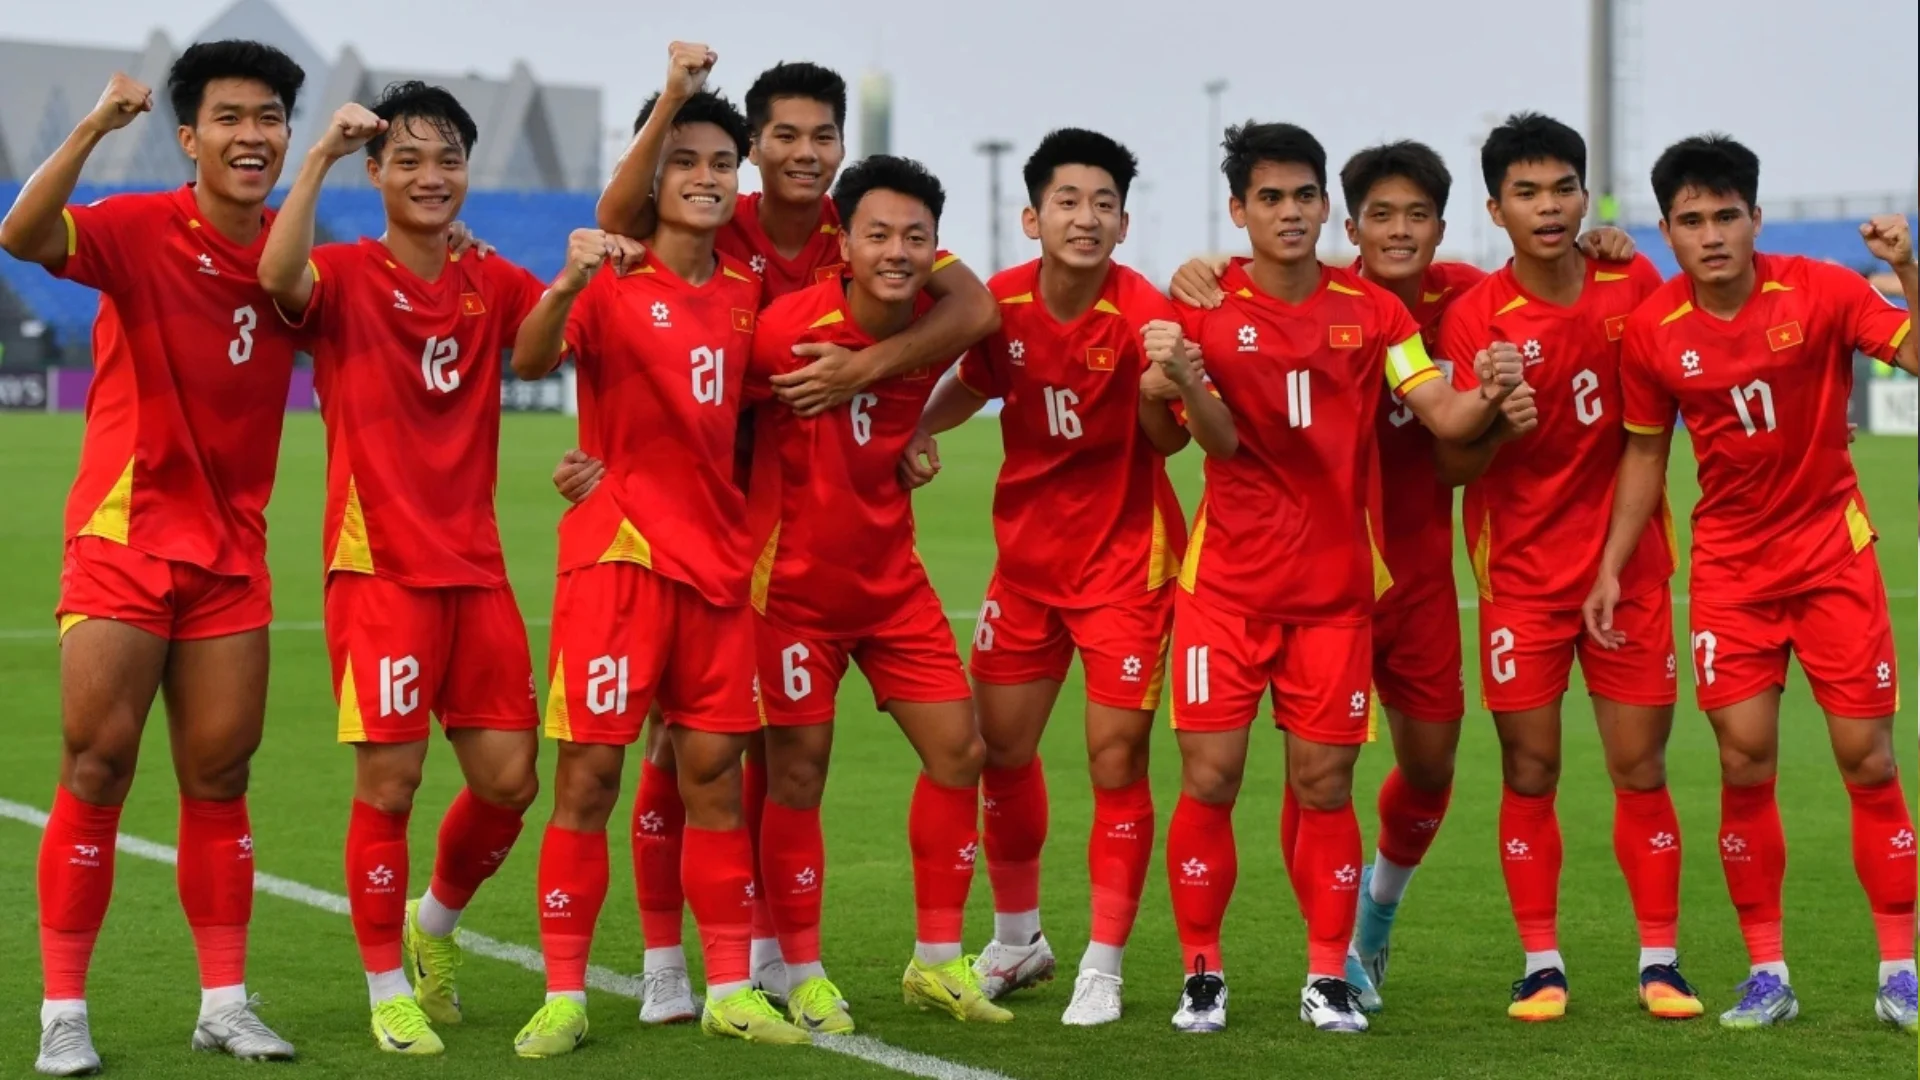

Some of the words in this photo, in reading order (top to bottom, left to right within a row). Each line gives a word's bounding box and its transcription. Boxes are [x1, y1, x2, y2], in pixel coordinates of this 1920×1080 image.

[228, 305, 257, 365] 3
[421, 335, 460, 394] 12
[690, 345, 724, 406] 21
[1286, 369, 1312, 429] 11
[1572, 368, 1603, 426] 2
[850, 392, 878, 447] 6
[1044, 386, 1083, 440] 16
[1730, 378, 1777, 438] 17
[973, 599, 1002, 651] 6
[586, 654, 629, 715] 21
[782, 642, 811, 701] 6
[1186, 645, 1209, 704] 11
[1490, 627, 1516, 684] 2
[1690, 629, 1718, 686] 17
[379, 655, 419, 717] 12
